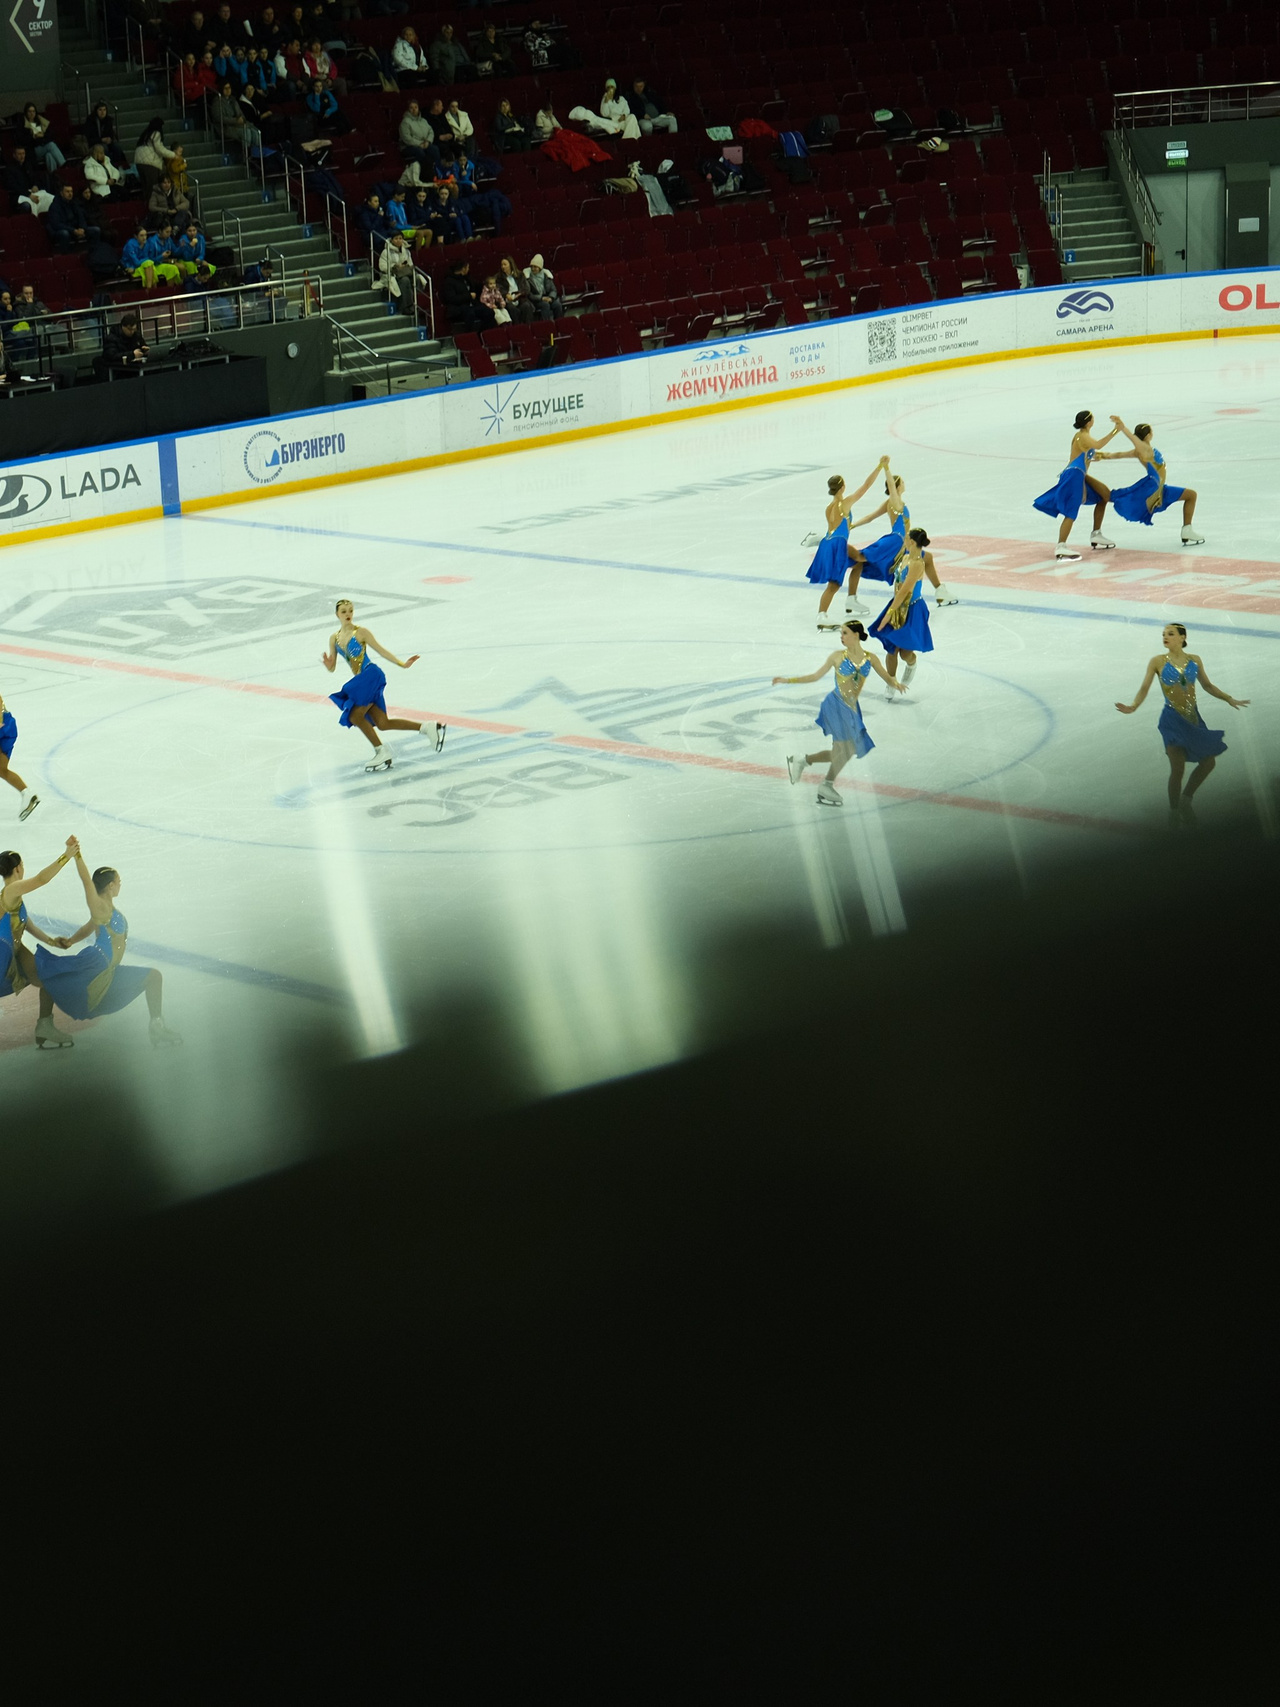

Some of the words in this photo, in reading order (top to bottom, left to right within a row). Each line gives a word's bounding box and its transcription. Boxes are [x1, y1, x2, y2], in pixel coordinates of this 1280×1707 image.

[28, 20, 53, 31] СЕКТОР
[901, 311, 933, 323] OLIMPBET
[902, 321, 939, 335] ЧЕМПИОНАТ
[941, 317, 968, 327] РОССИИ
[1056, 326, 1087, 336] САМАРА
[1088, 324, 1114, 332] АРЕНА
[902, 338, 911, 346] ПО
[913, 334, 938, 344] ХОККЕЮ
[945, 330, 958, 339] ВХЛ
[789, 341, 825, 355] ДОСТАВКА
[902, 346, 937, 358] Мобильное
[938, 340, 979, 352] приложение
[681, 355, 763, 378] ЖИГУЛЁВСКАЯ
[790, 365, 826, 380] 955-05-55
[513, 393, 584, 420] БУДУЩЕЕ
[513, 418, 558, 432] ПЕНСИОННЫЙ
[560, 415, 579, 424] ФОНД
[281, 432, 345, 465] БУРЭНЕРГО
[60, 463, 141, 500] LADA
